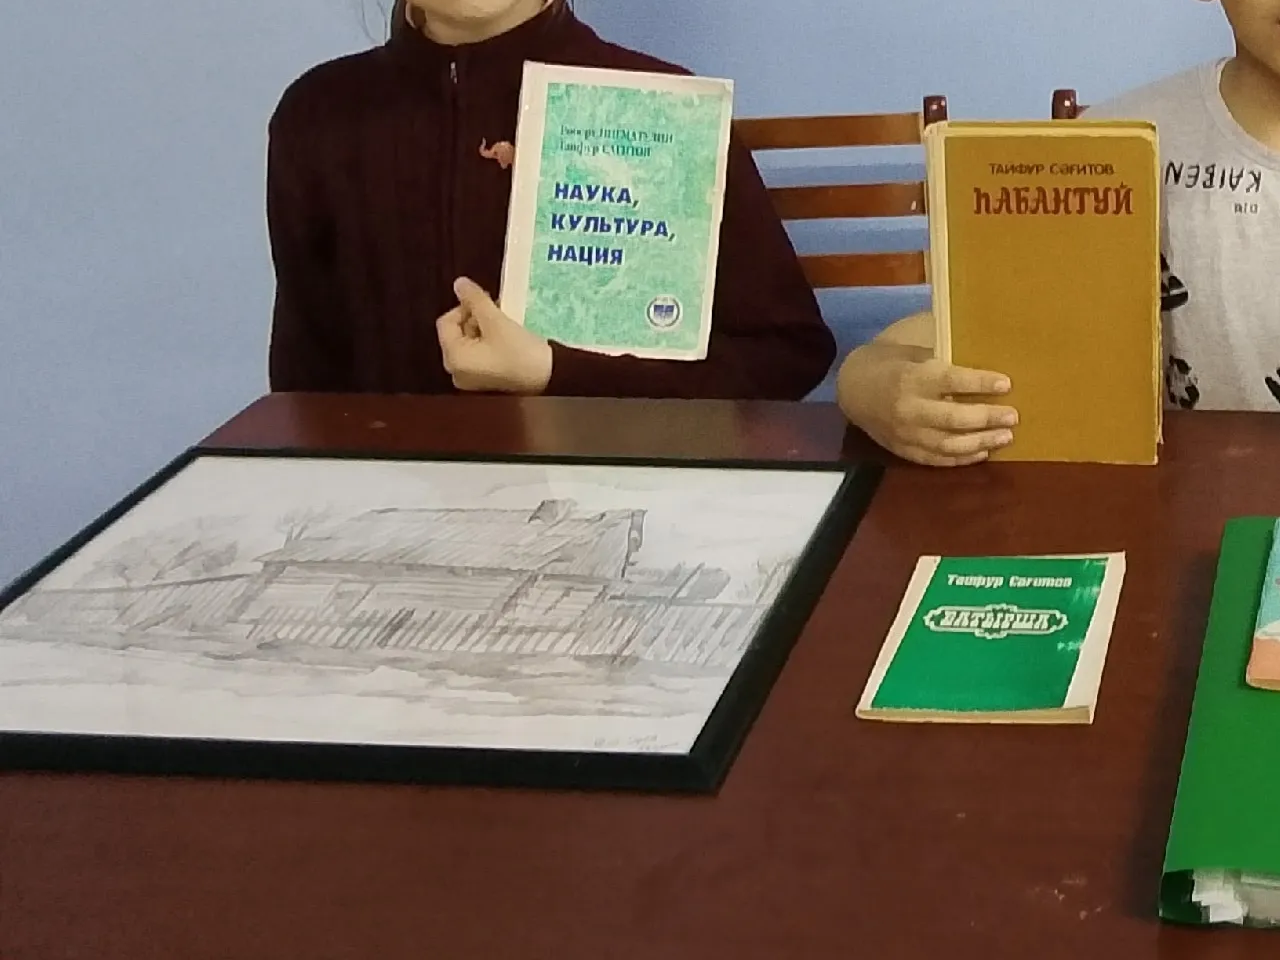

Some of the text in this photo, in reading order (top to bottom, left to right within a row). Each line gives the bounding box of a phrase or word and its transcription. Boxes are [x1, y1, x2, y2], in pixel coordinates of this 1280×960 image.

[1164, 161, 1263, 193] KAIBEN
[554, 181, 640, 208] НАУКА,
[550, 214, 676, 242] КУЛЬТУРА,
[547, 243, 624, 266] НАЦИЯ
